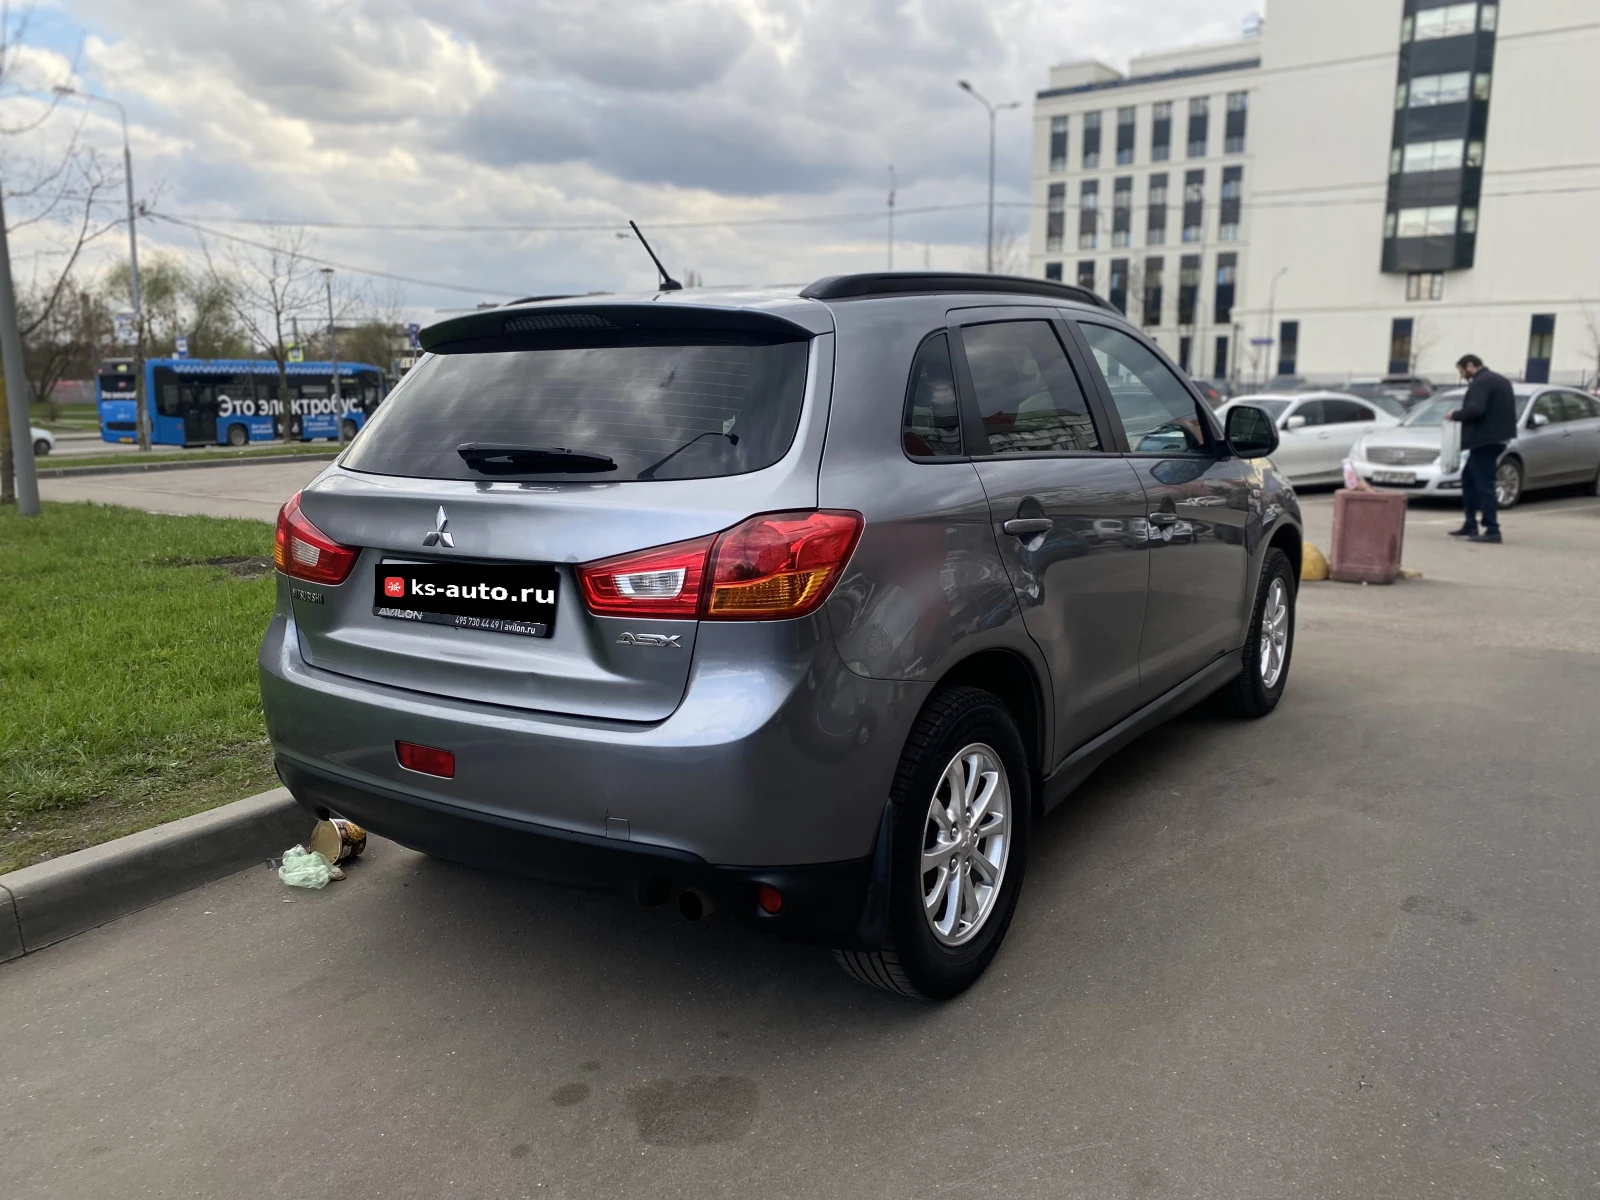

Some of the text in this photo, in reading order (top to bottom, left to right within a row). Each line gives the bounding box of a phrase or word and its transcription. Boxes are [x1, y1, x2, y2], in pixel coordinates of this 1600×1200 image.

[217, 394, 255, 417] Это
[377, 607, 423, 620] AVILON
[455, 616, 536, 634] 495 730 44 49 avilon.ru
[616, 631, 682, 648] ASX
